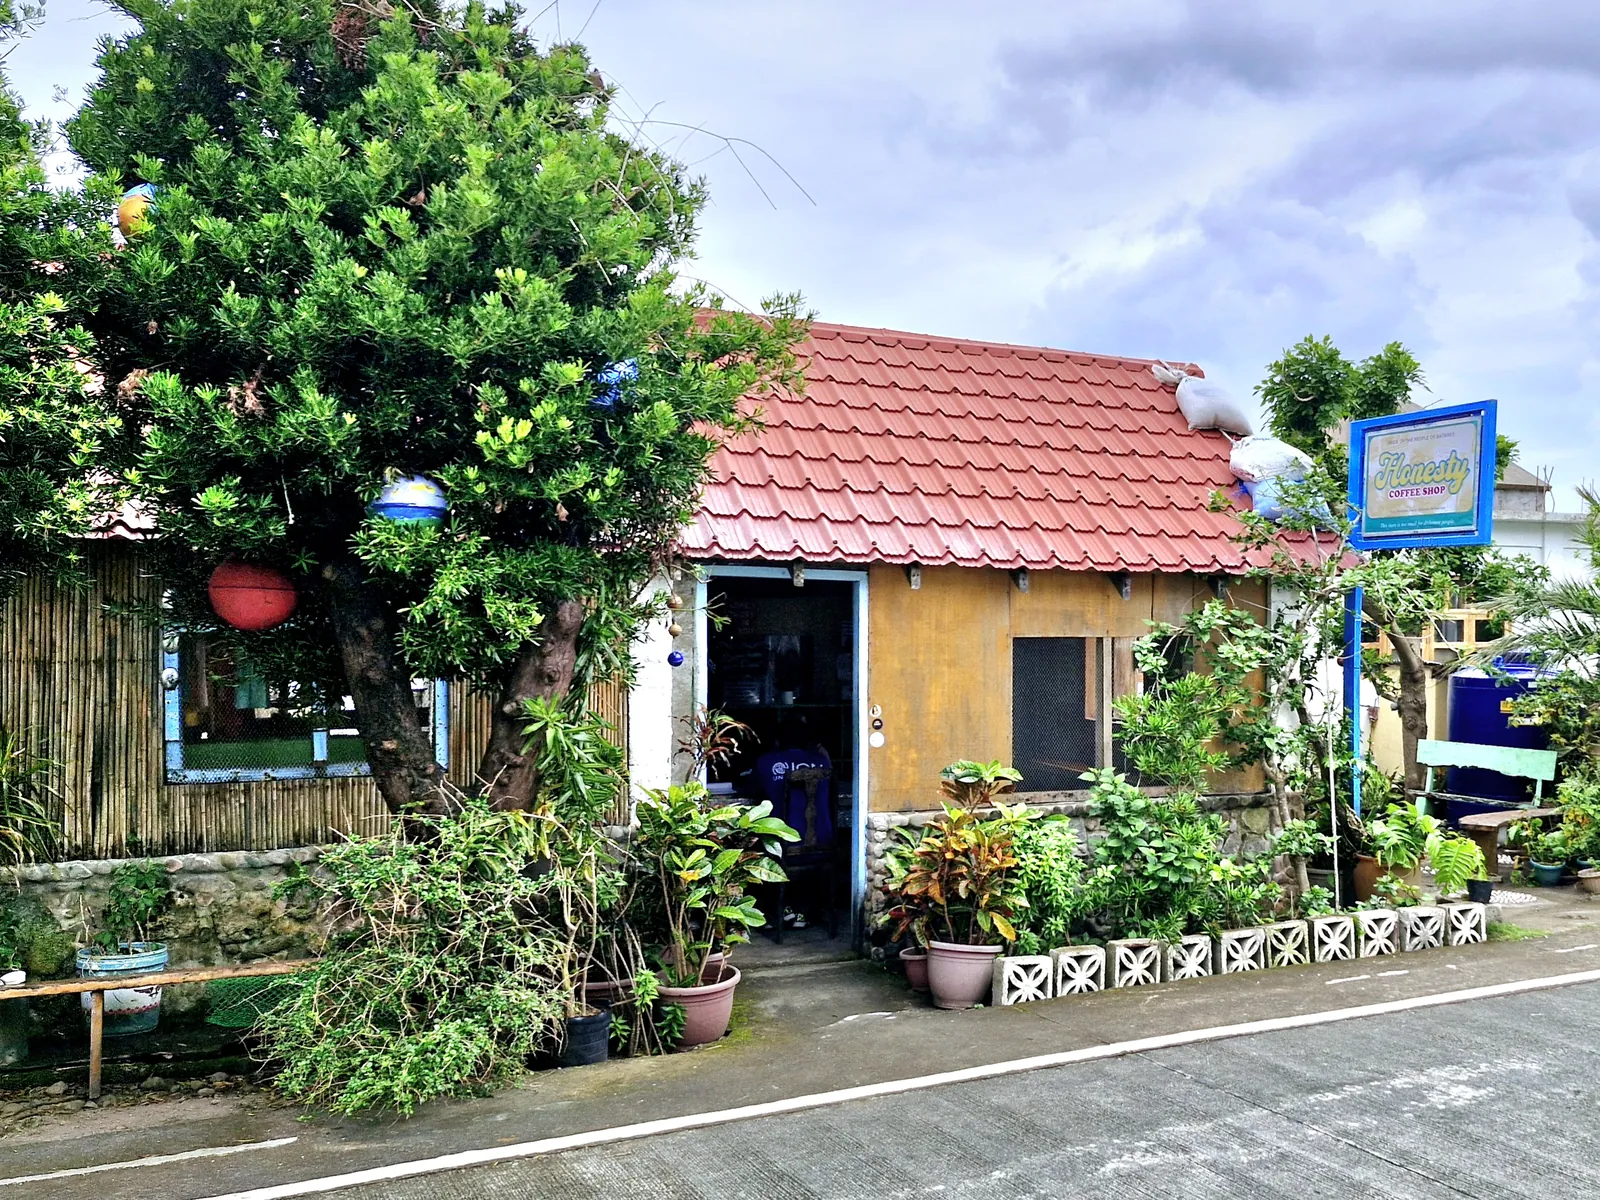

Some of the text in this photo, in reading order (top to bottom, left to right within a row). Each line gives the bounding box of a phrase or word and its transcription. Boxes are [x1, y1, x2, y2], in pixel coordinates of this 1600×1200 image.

[1374, 450, 1471, 494] Honesty
[1389, 486, 1446, 498] COFFEE SHOP
